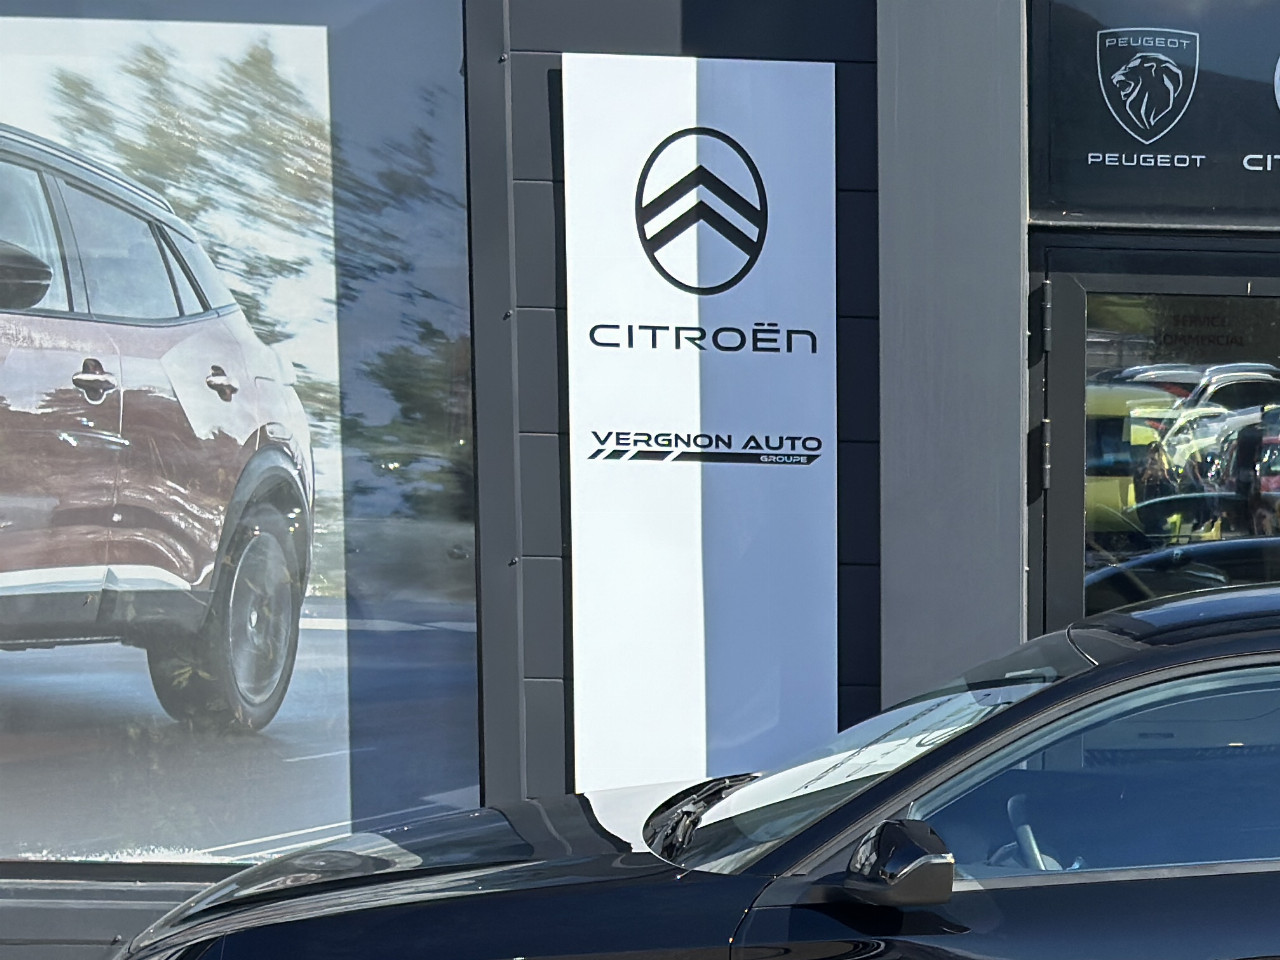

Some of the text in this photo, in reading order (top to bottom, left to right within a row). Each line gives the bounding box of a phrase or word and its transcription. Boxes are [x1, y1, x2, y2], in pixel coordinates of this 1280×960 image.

[1105, 36, 1190, 49] PEUGEOT
[1087, 154, 1206, 168] PEUGEOT
[589, 322, 817, 354] CITROËN
[591, 430, 822, 452] VERGNON AUTO
[760, 455, 808, 464] GROUPE
